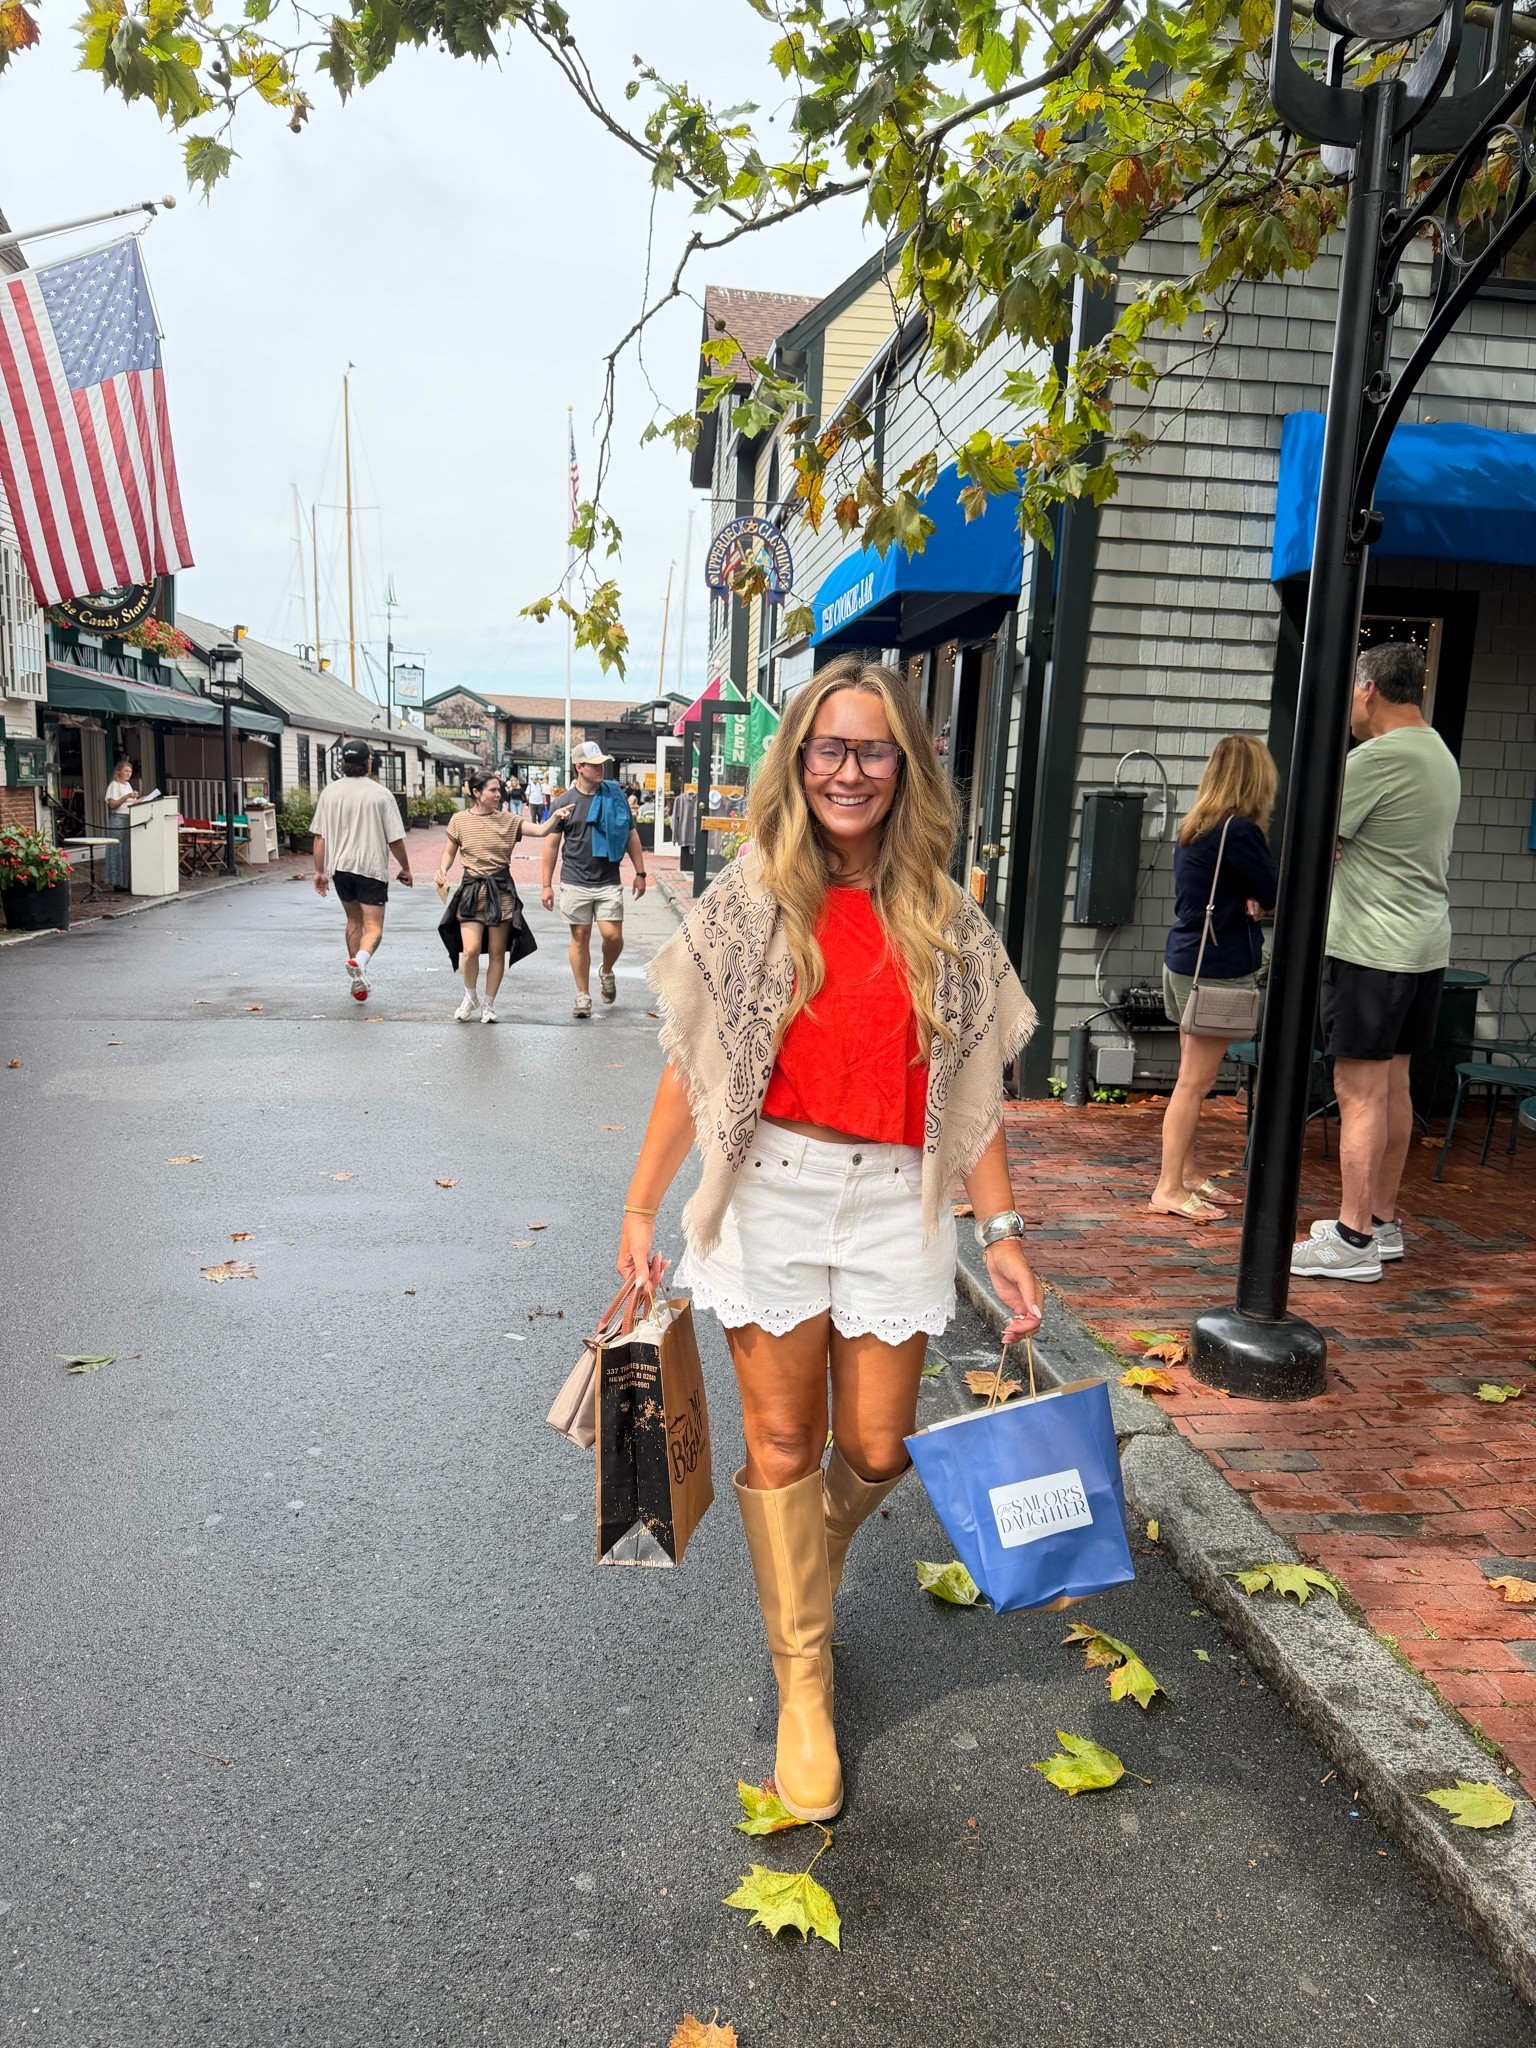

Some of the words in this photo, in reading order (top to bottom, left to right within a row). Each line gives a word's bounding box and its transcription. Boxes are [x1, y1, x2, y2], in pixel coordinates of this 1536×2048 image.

[758, 522, 791, 579] CLOTHING
[61, 598, 77, 615] he
[79, 610, 119, 629] Candy
[121, 596, 149, 623] Store
[821, 603, 834, 635] THE
[833, 583, 859, 626] COOKIE
[858, 572, 874, 609] JAR
[731, 713, 747, 763] OPEN
[606, 1367, 619, 1375] 337
[640, 1363, 658, 1373] STREET
[996, 1502, 1013, 1518] The
[1011, 1485, 1082, 1515] SAILOR'S
[1000, 1499, 1087, 1534] DAUGHTER
